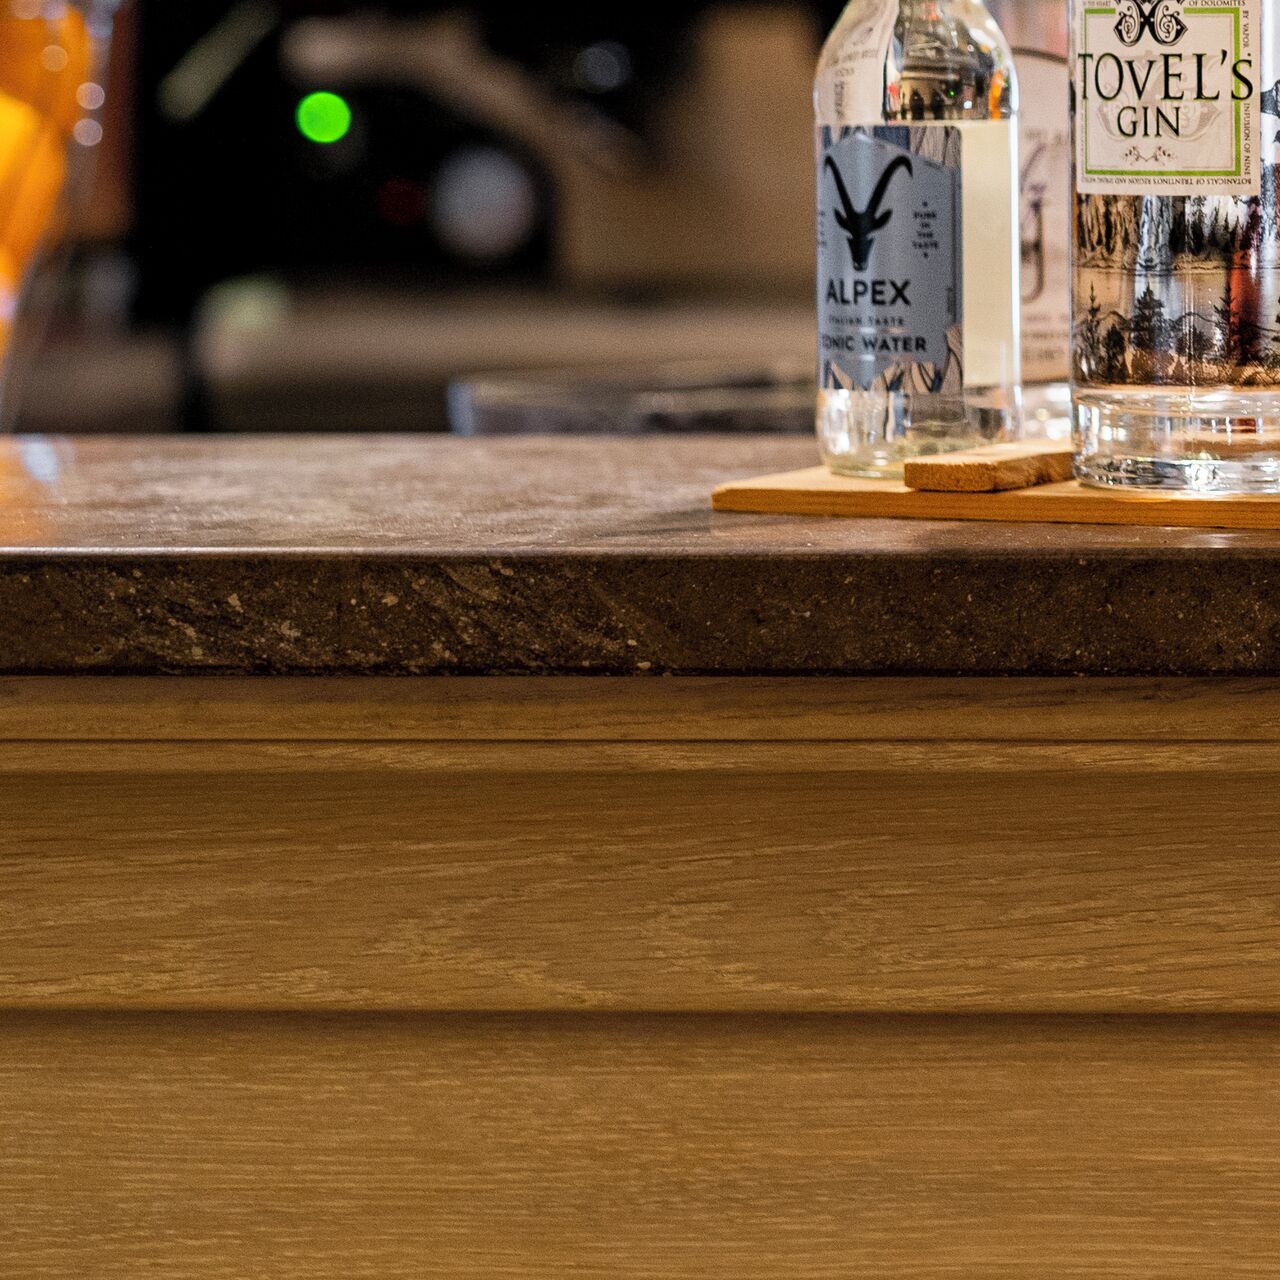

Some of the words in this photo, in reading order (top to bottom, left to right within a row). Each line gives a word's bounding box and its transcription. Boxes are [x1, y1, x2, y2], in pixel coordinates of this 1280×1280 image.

[1189, 0, 1199, 7] OF
[1200, 0, 1246, 7] DOLOMITES
[1077, 49, 1254, 101] TOVEL'S
[1117, 105, 1181, 137] GIN
[826, 278, 912, 306] ALPEX
[862, 336, 927, 352] WATER
